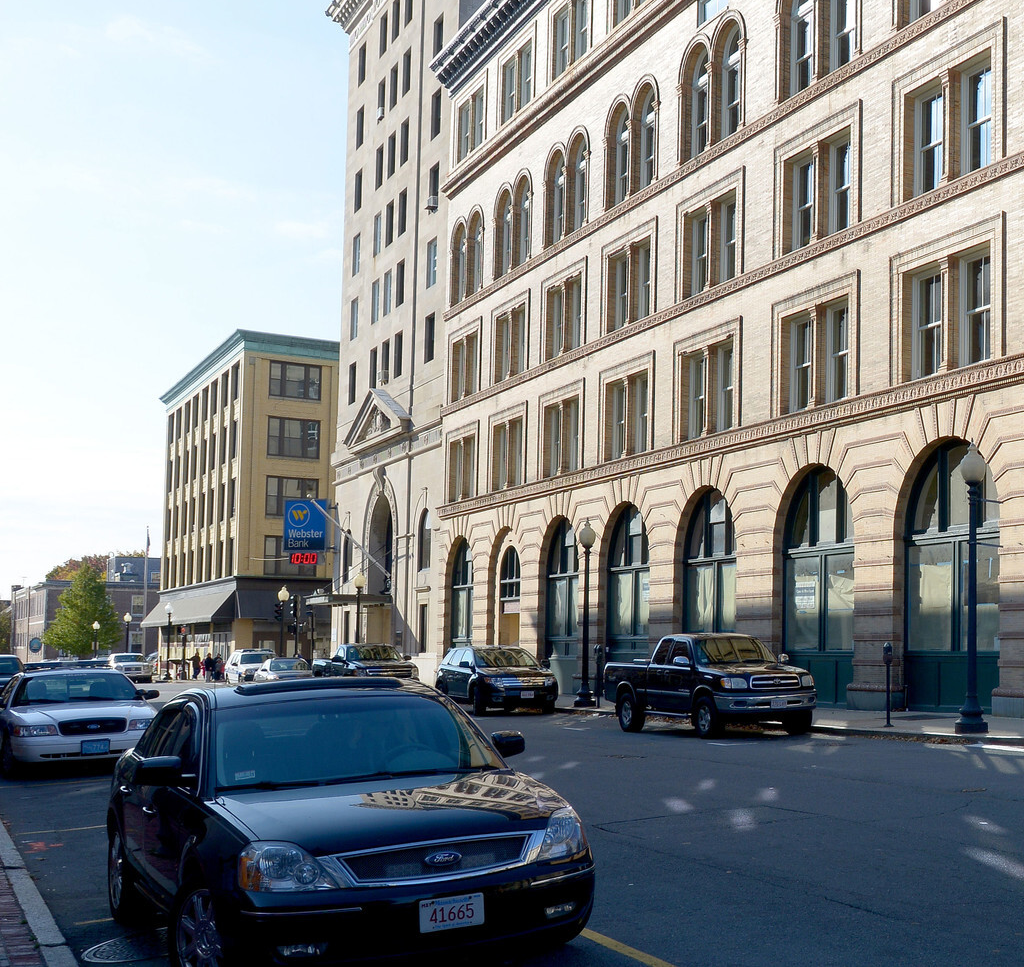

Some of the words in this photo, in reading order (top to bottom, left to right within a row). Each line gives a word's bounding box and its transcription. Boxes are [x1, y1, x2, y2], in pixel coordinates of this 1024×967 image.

[288, 529, 323, 538] Webster
[288, 538, 309, 548] Bank
[290, 552, 318, 565] 10:00
[433, 853, 454, 863] Ford
[429, 902, 475, 924] 41665
